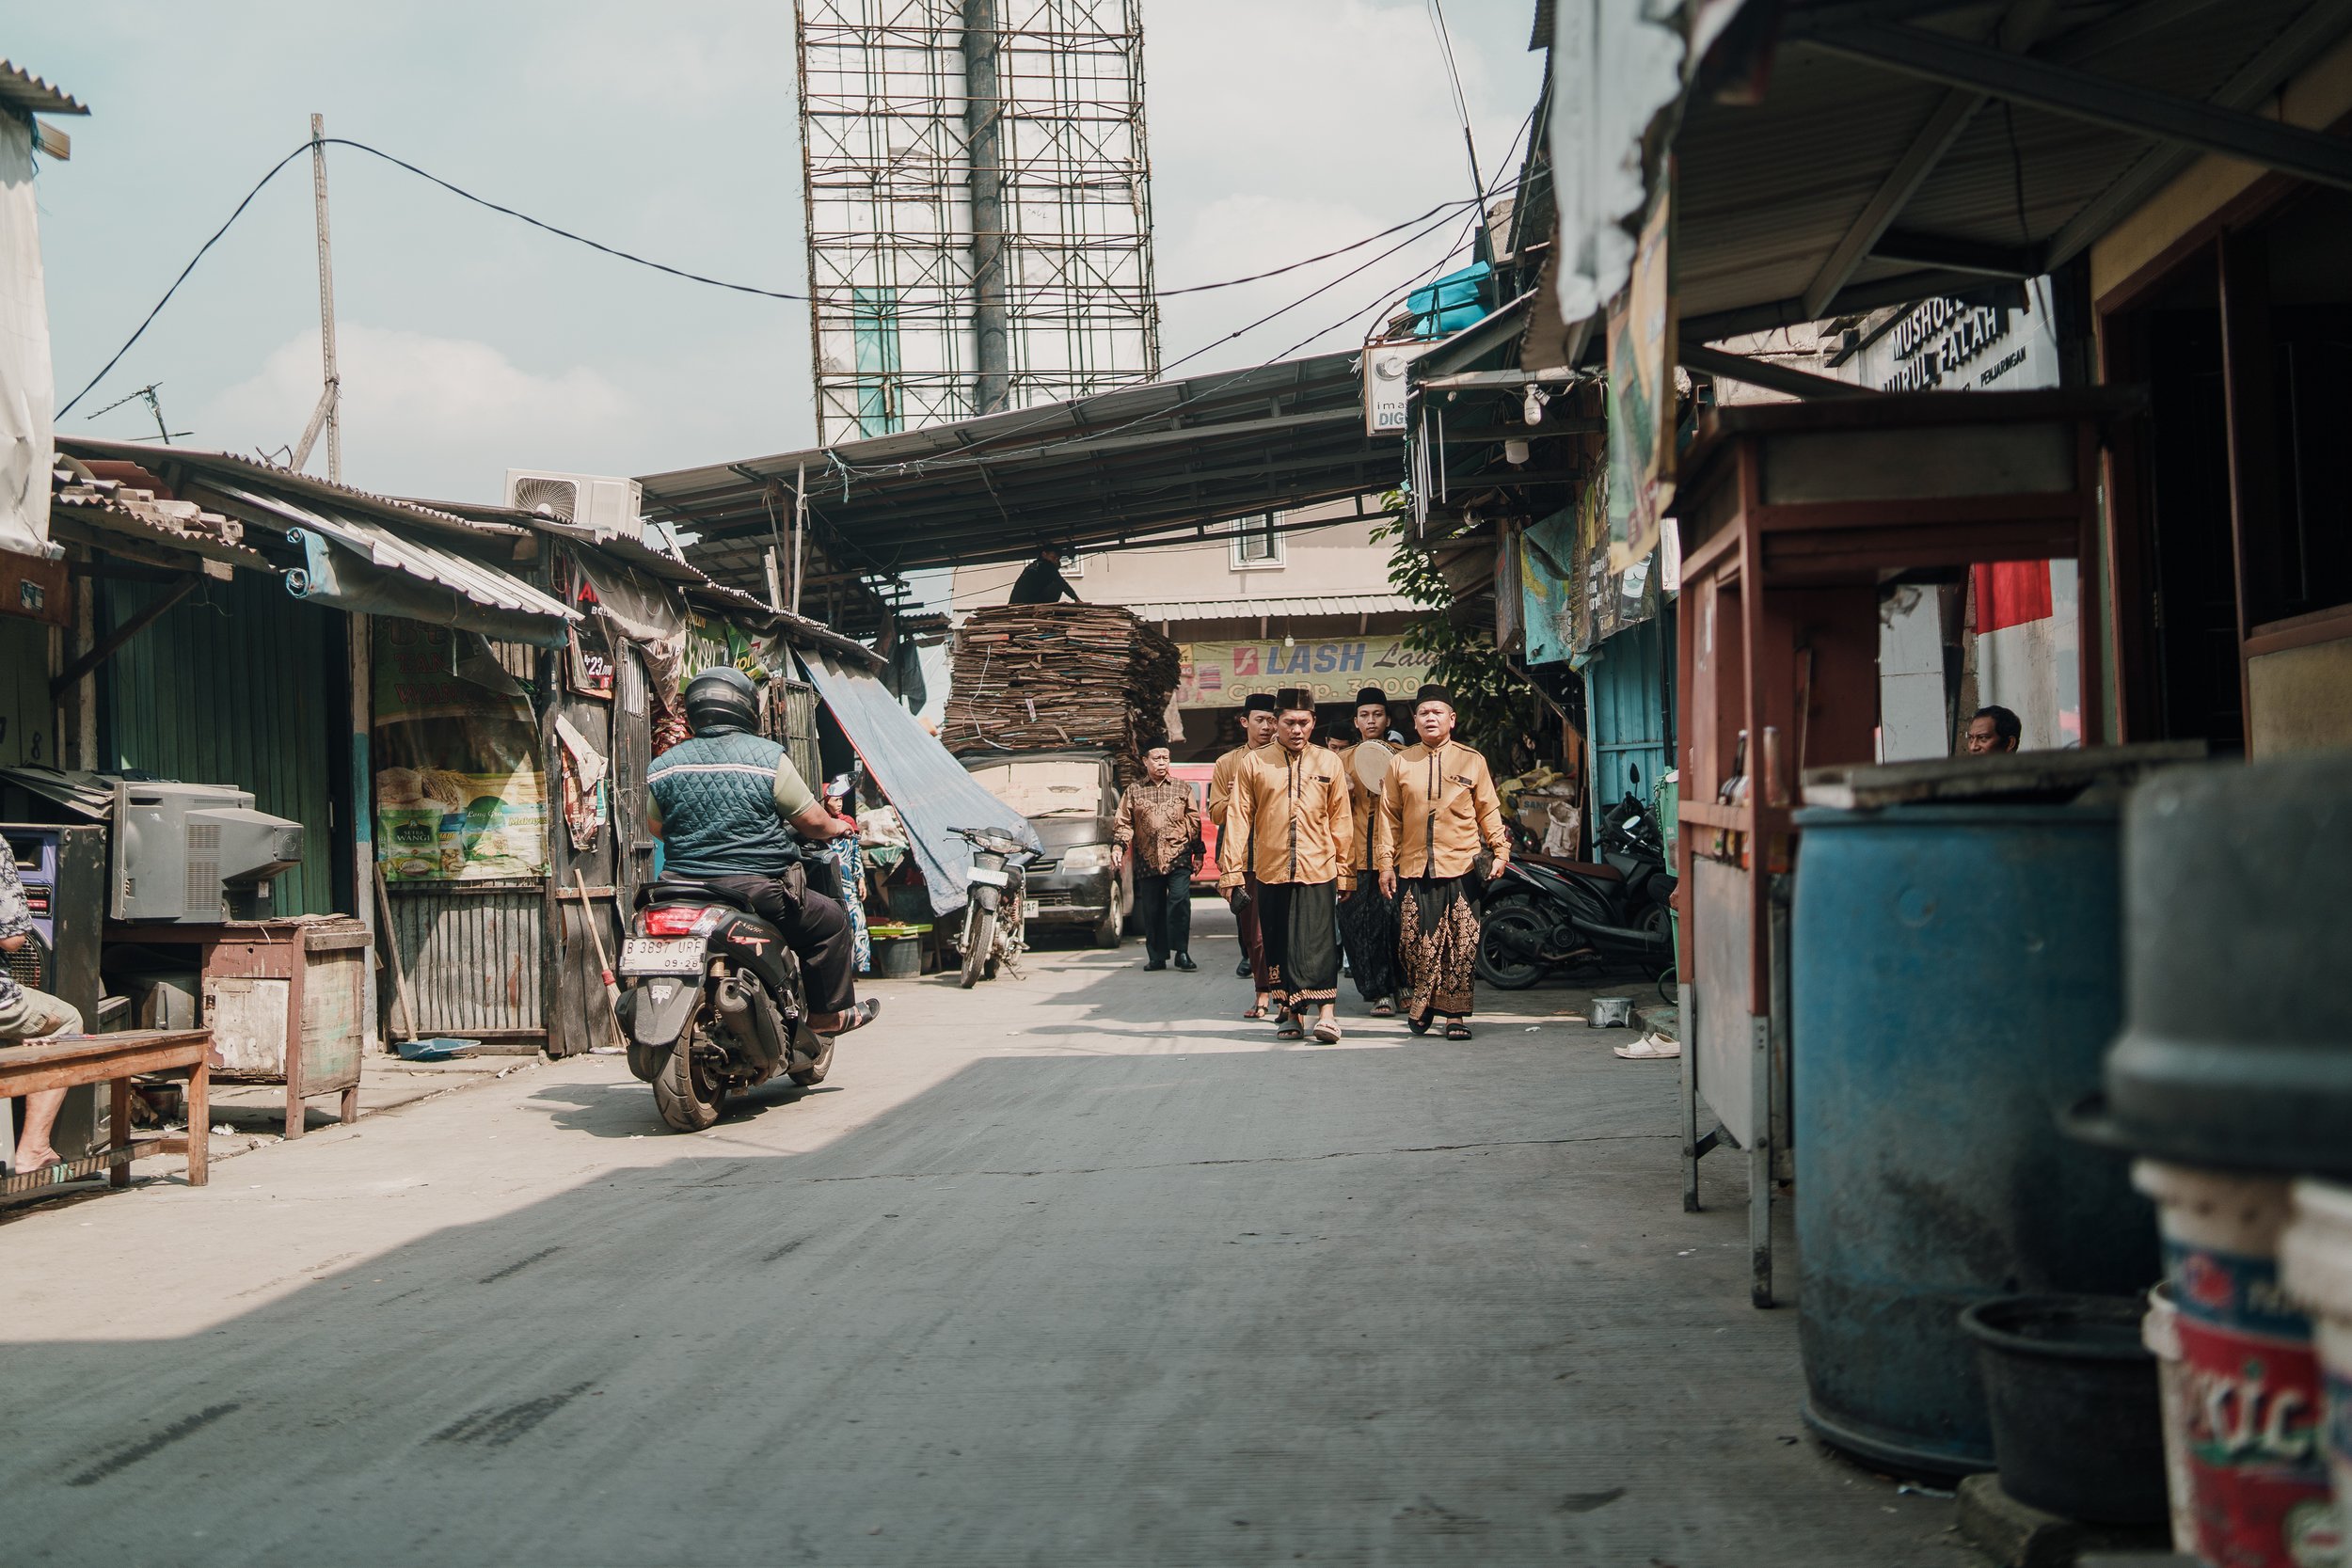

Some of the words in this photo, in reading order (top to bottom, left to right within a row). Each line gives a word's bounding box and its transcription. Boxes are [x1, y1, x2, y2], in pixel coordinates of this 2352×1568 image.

[1939, 308, 1997, 372] FALAH
[1980, 346, 2026, 387] PENJARINGAN
[1265, 642, 1366, 675] LASH
[627, 942, 634, 954] B
[640, 941, 671, 954] 3897
